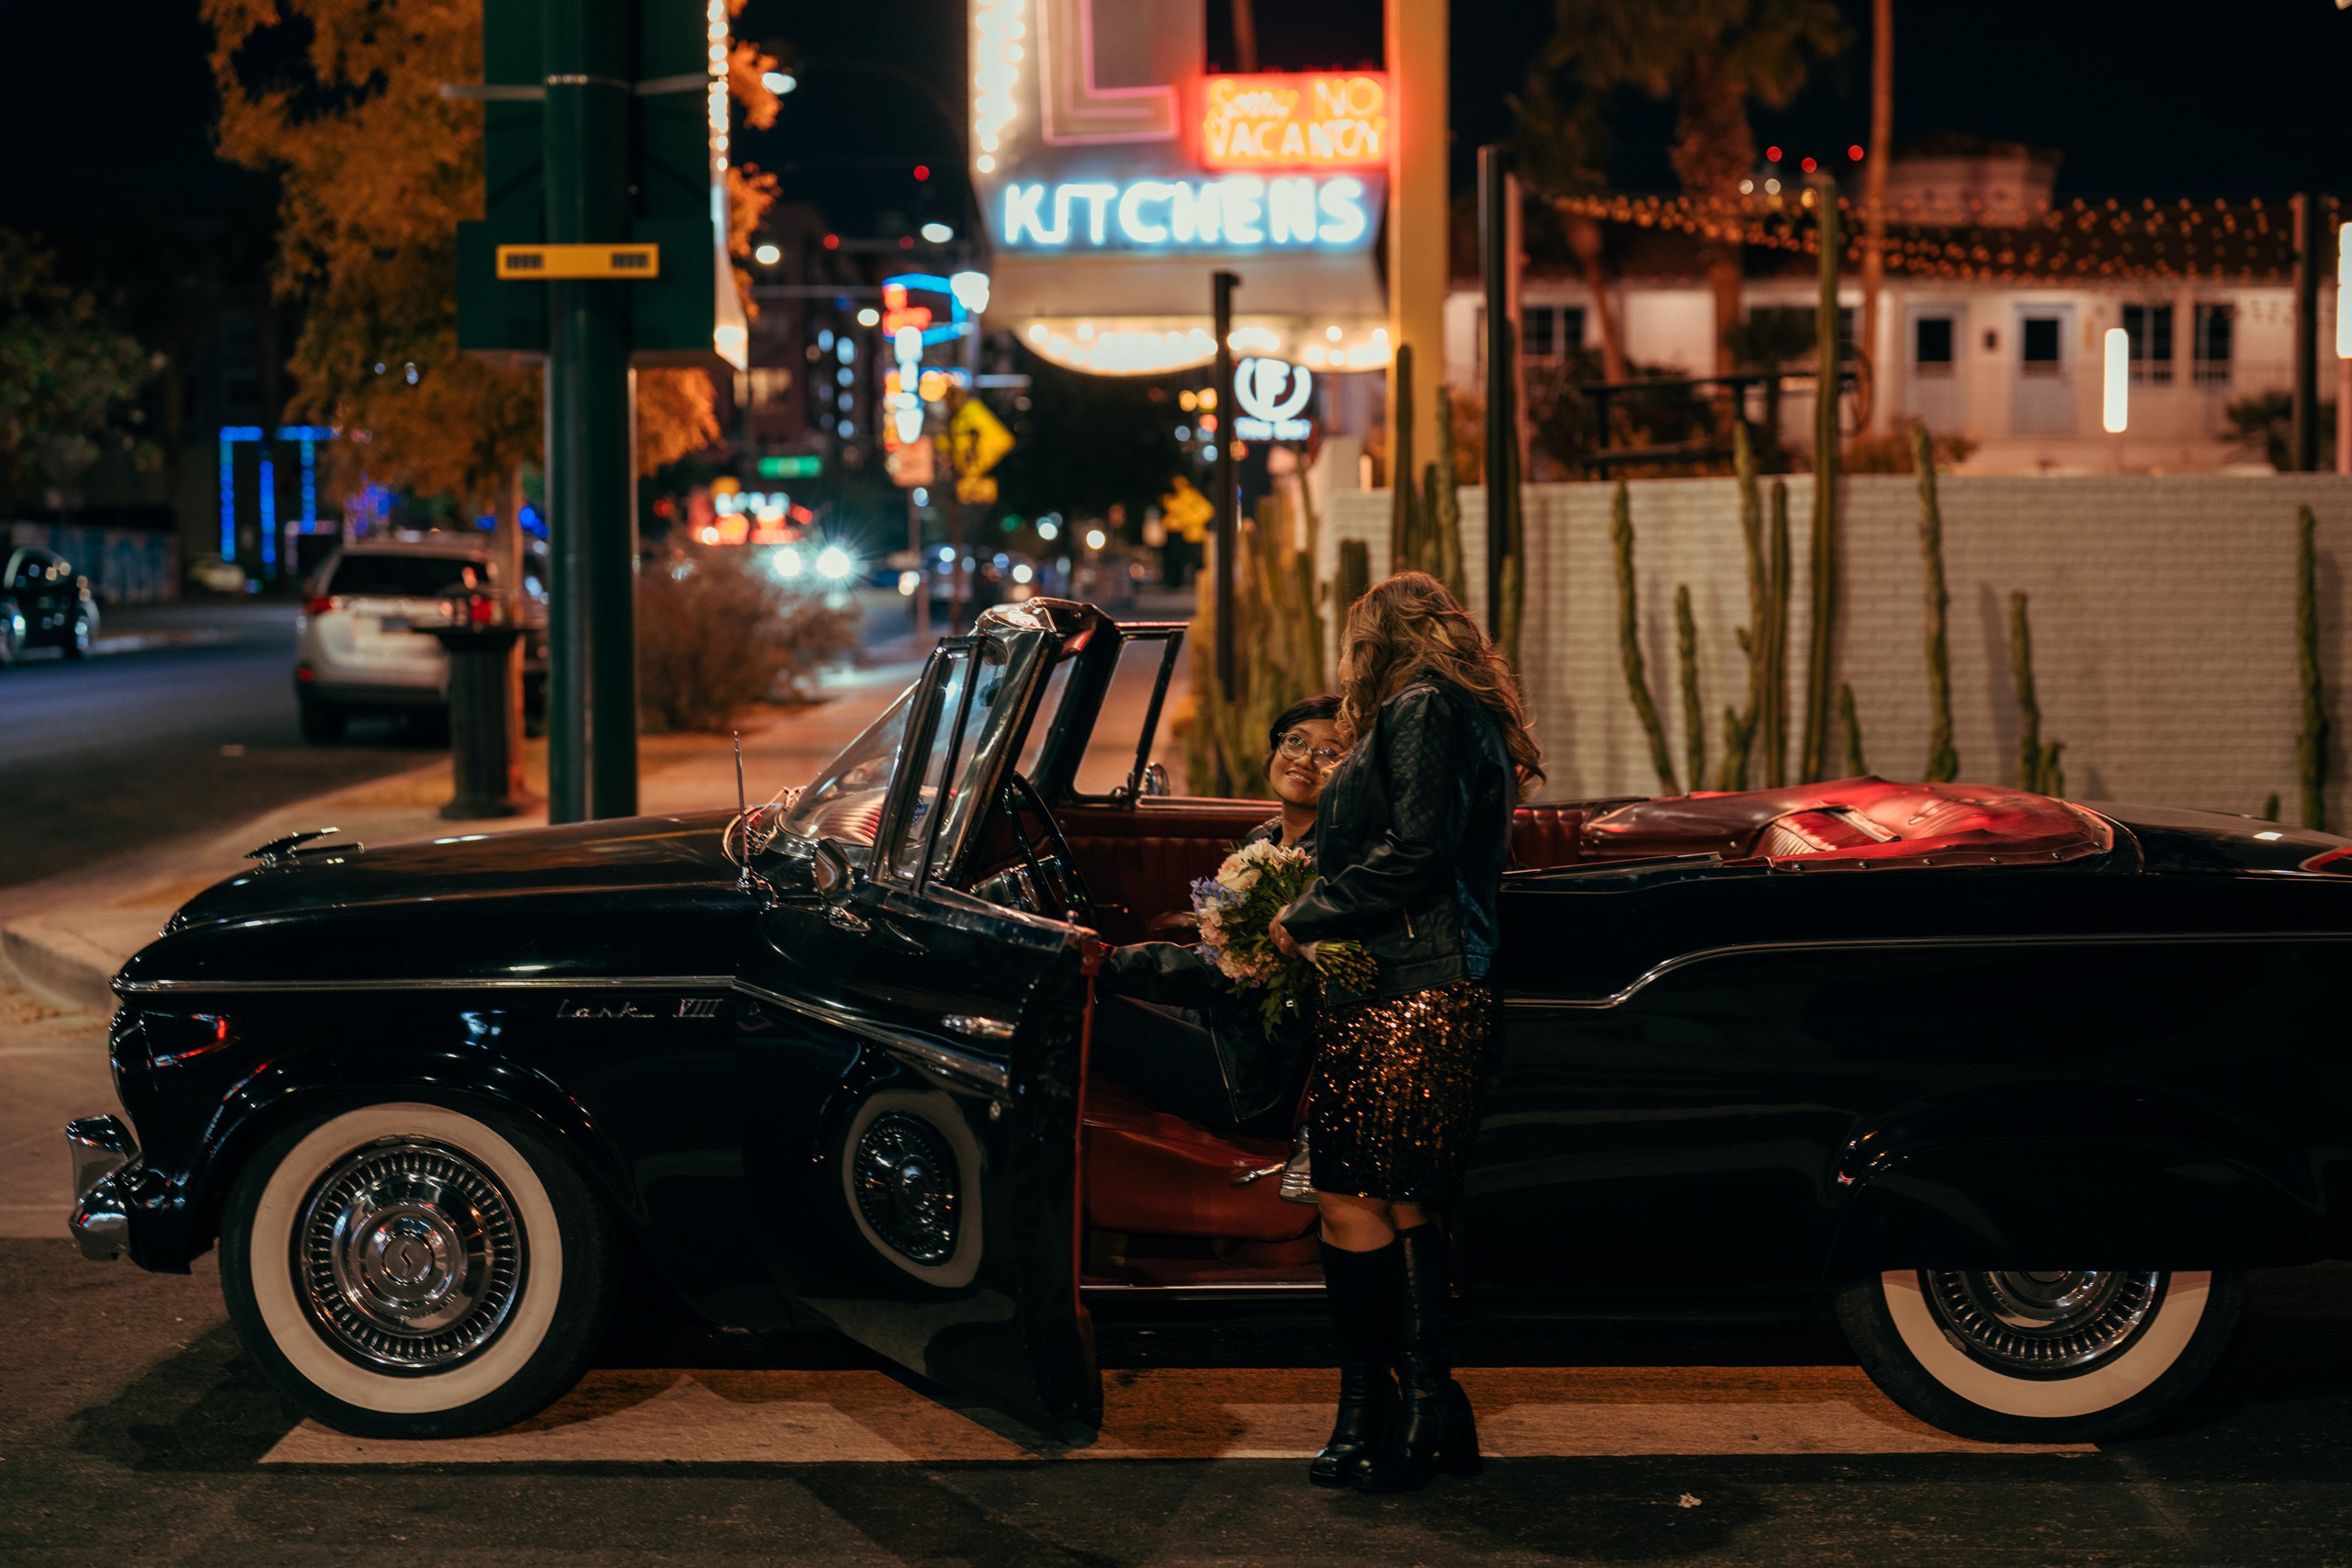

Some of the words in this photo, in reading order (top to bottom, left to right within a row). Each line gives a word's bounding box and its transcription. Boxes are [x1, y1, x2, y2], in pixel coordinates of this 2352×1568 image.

[1314, 77, 1384, 119] NO
[1204, 117, 1386, 164] VACANCY
[1004, 177, 1366, 245] KITCHENS
[672, 998, 724, 1018] VIII
